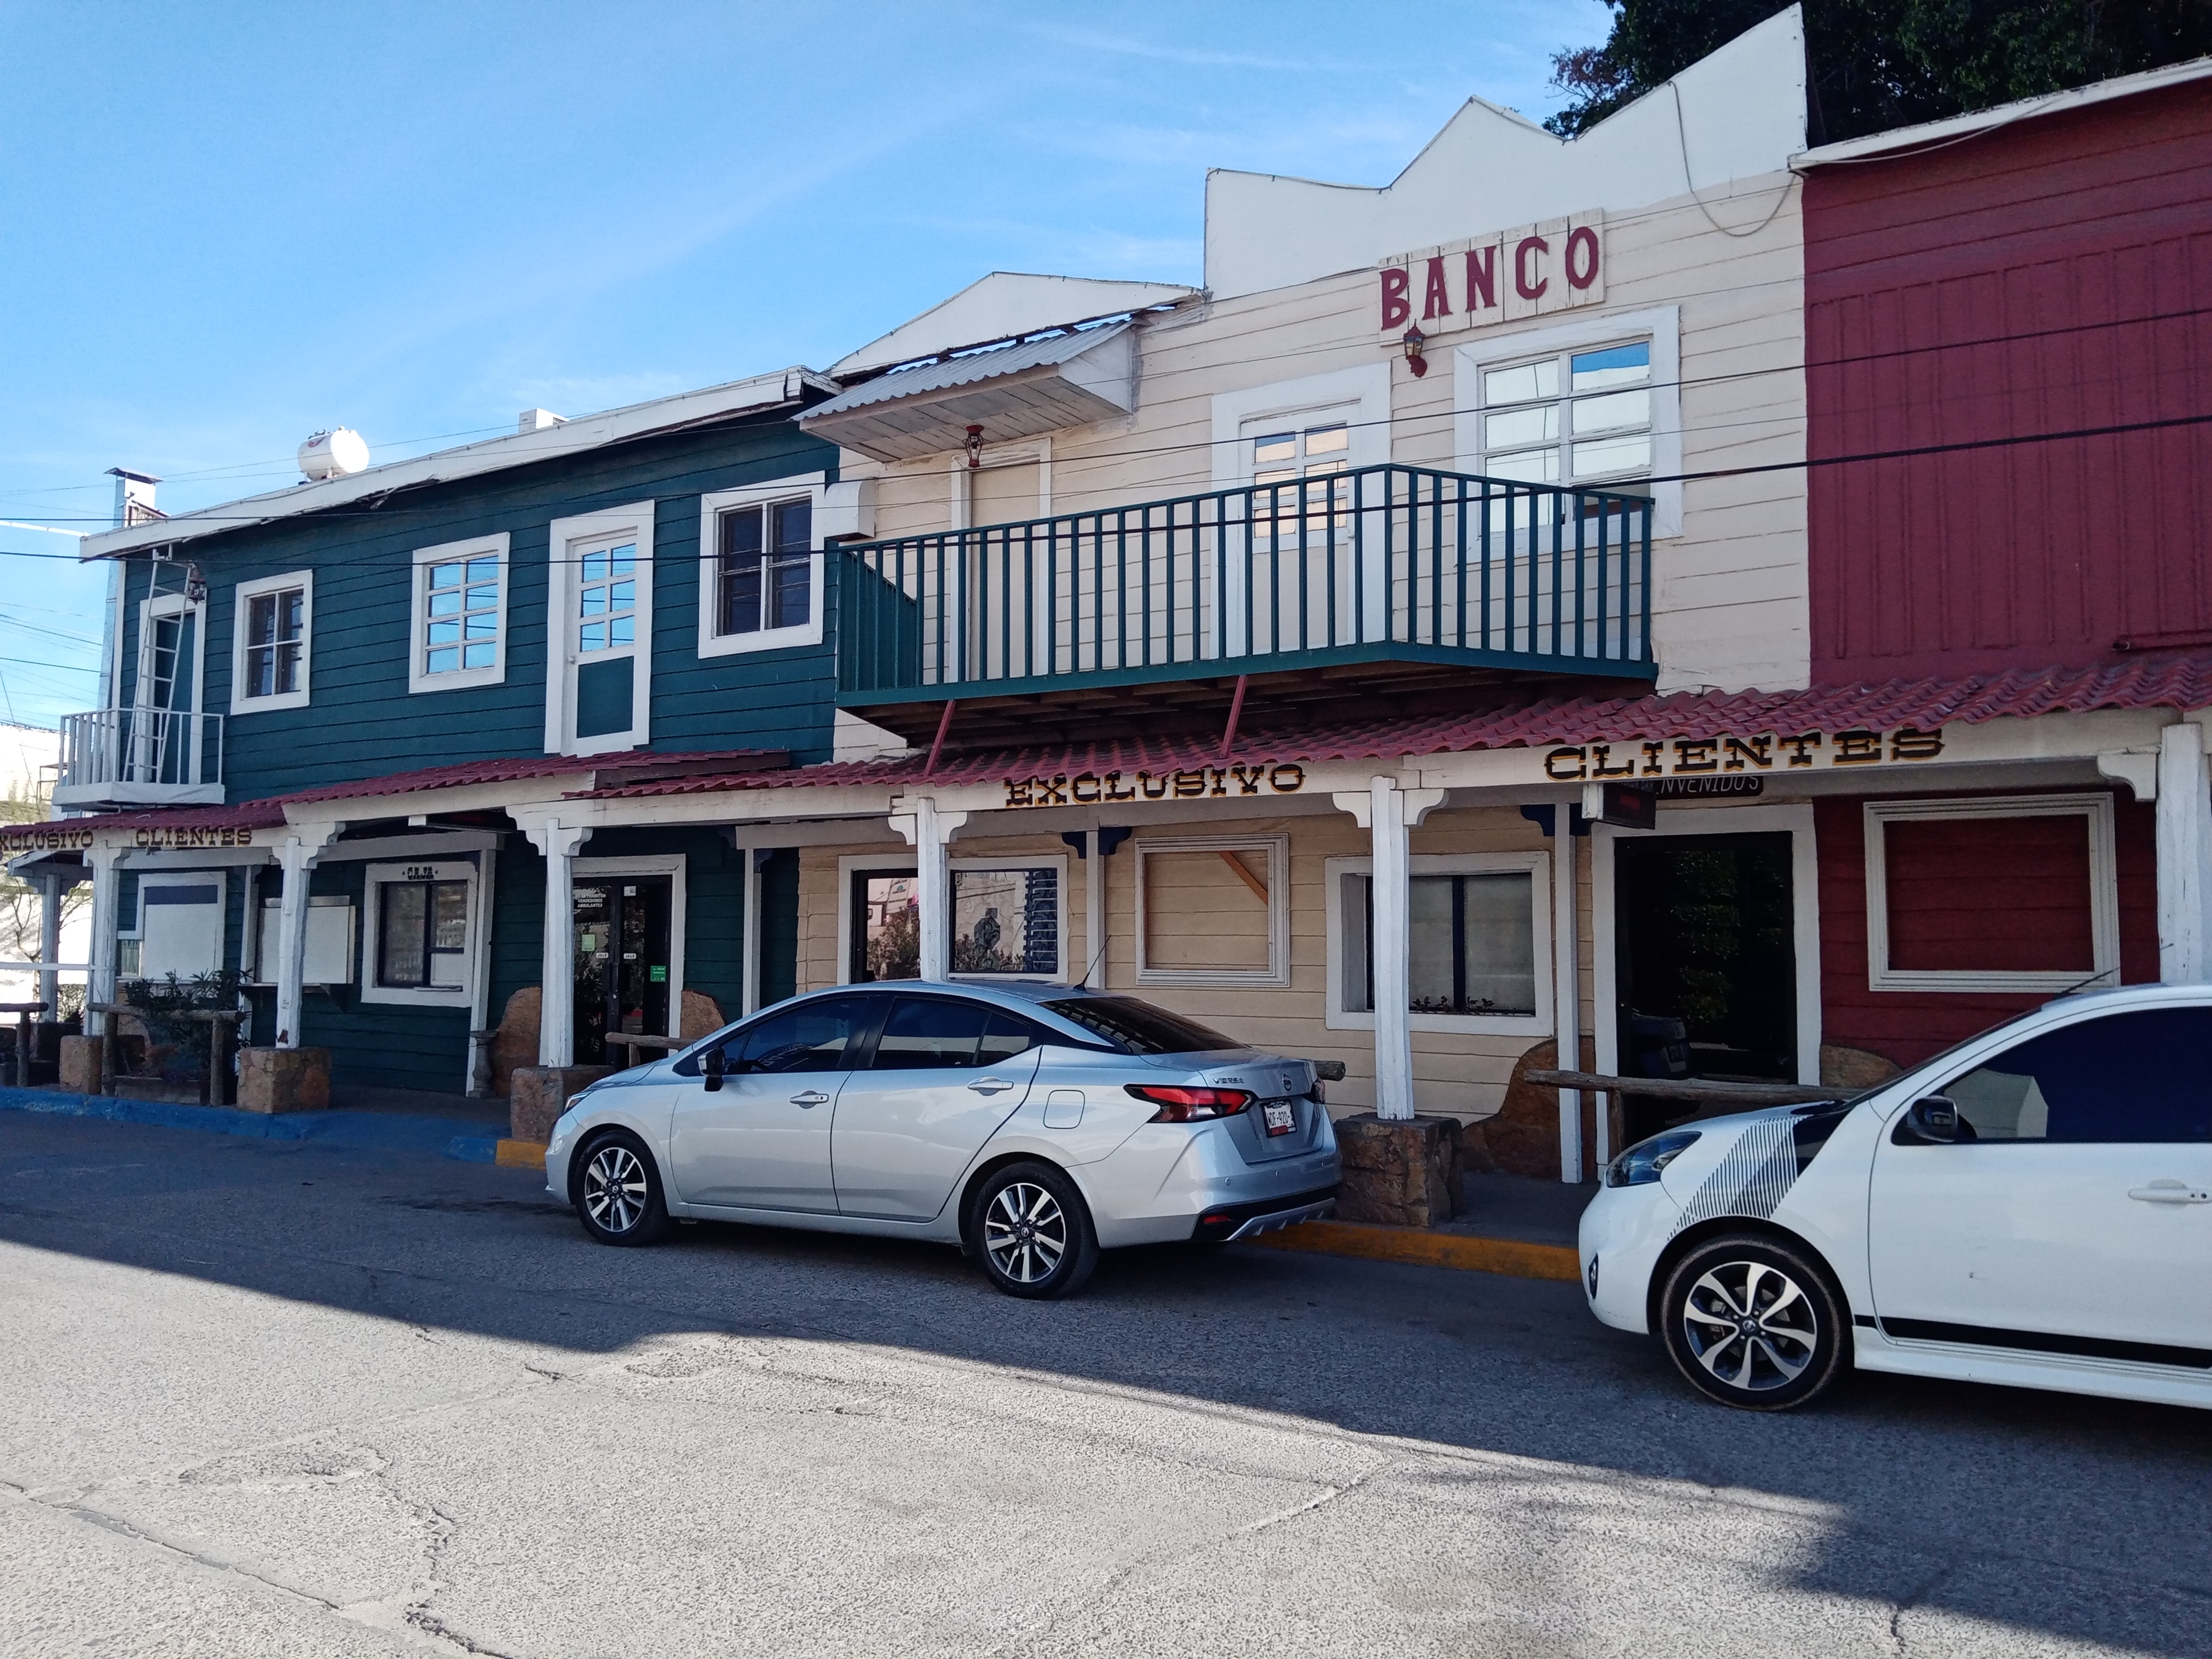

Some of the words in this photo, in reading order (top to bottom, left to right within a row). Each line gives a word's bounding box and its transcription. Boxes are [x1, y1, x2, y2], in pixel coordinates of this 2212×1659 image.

[1379, 226, 1598, 330] BANCO
[1004, 764, 1306, 808] EXCLUSIVO
[1544, 727, 1946, 781] CLIENTES
[136, 827, 253, 847] CLIENTES
